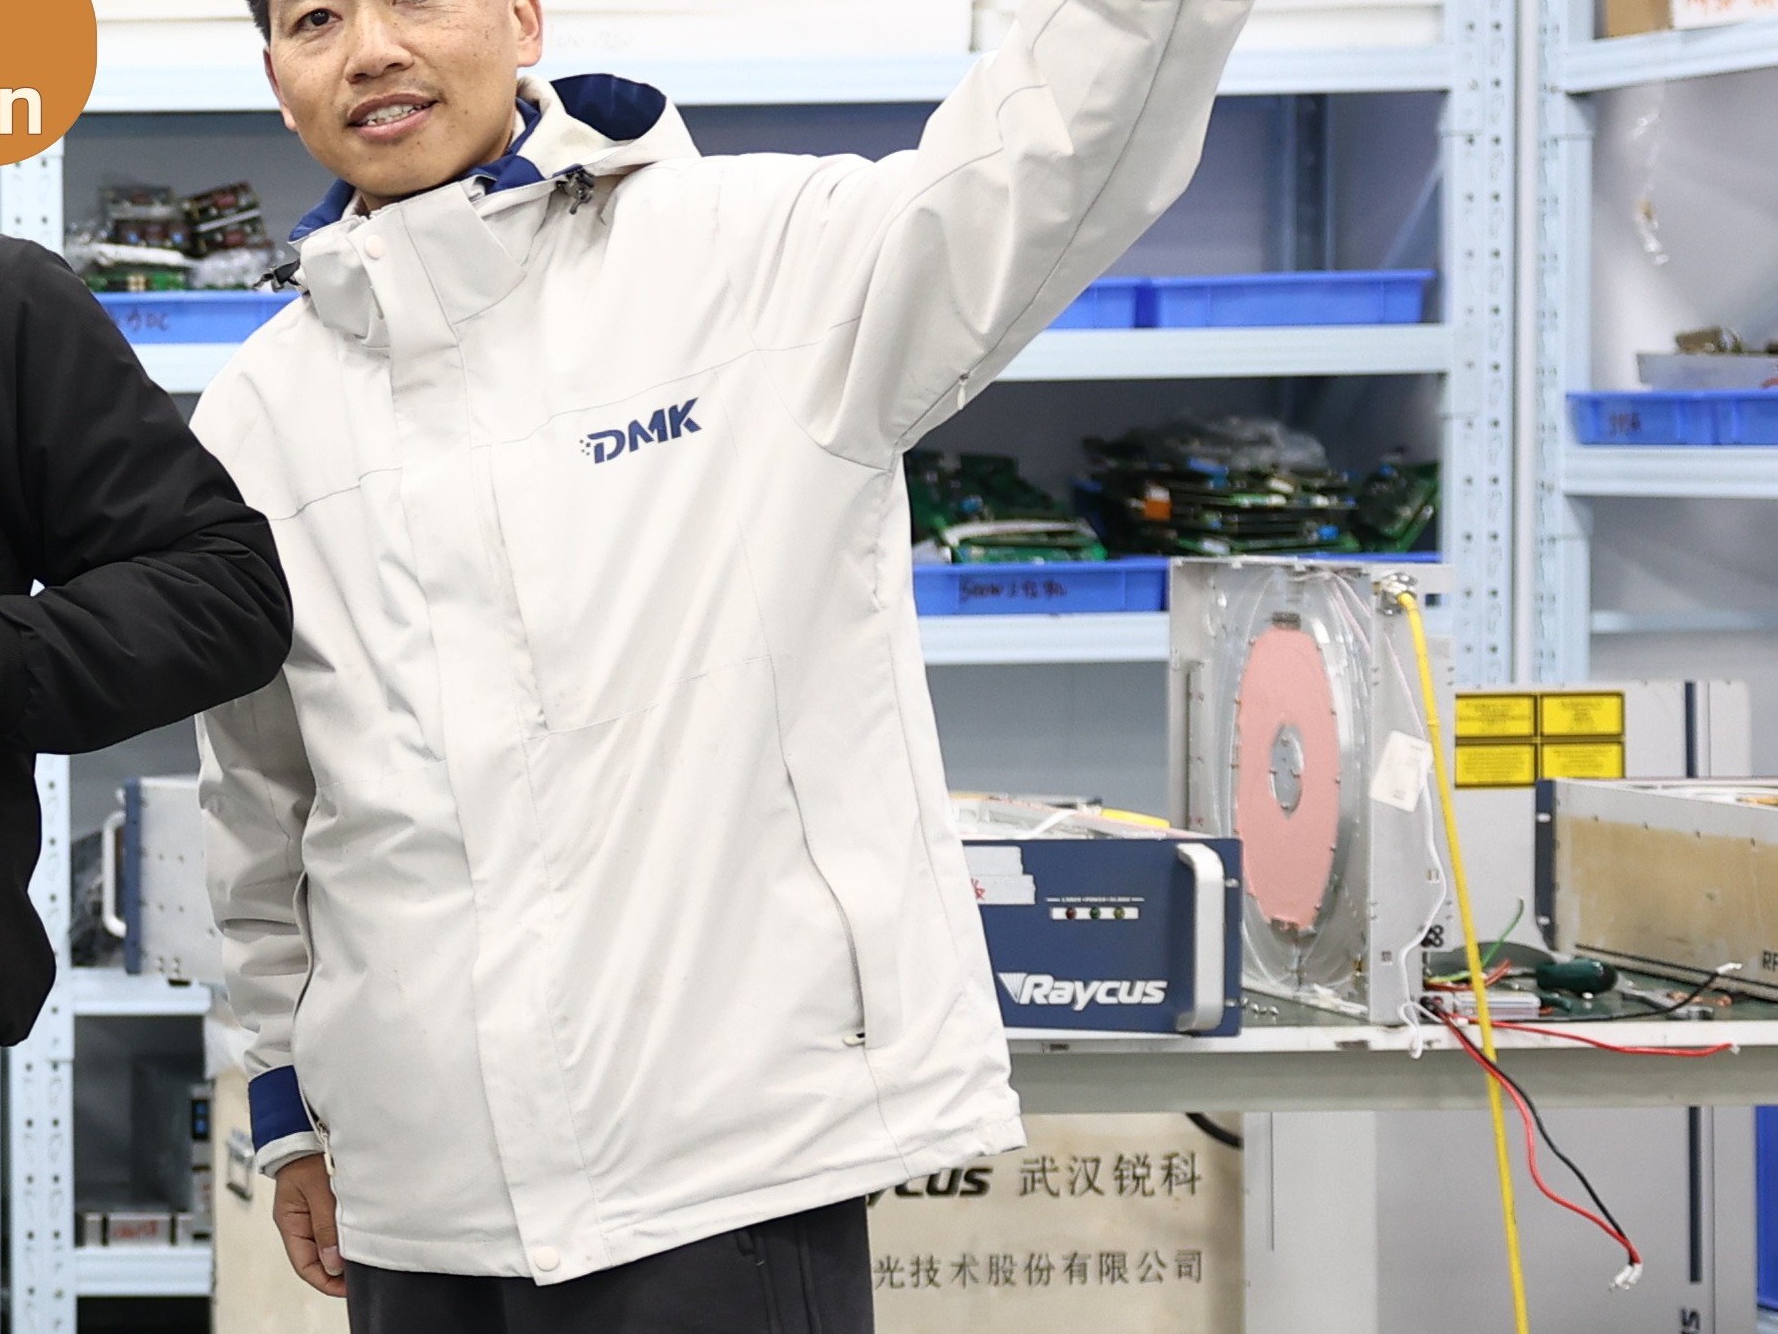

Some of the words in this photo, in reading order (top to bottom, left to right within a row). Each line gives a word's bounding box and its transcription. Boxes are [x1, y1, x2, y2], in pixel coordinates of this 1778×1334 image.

[582, 396, 702, 464] DMK
[1019, 974, 1168, 1011] Raycus
[1018, 1150, 1203, 1198] 武汉锐科
[873, 1248, 1204, 1291] 光技术股份有限公司
